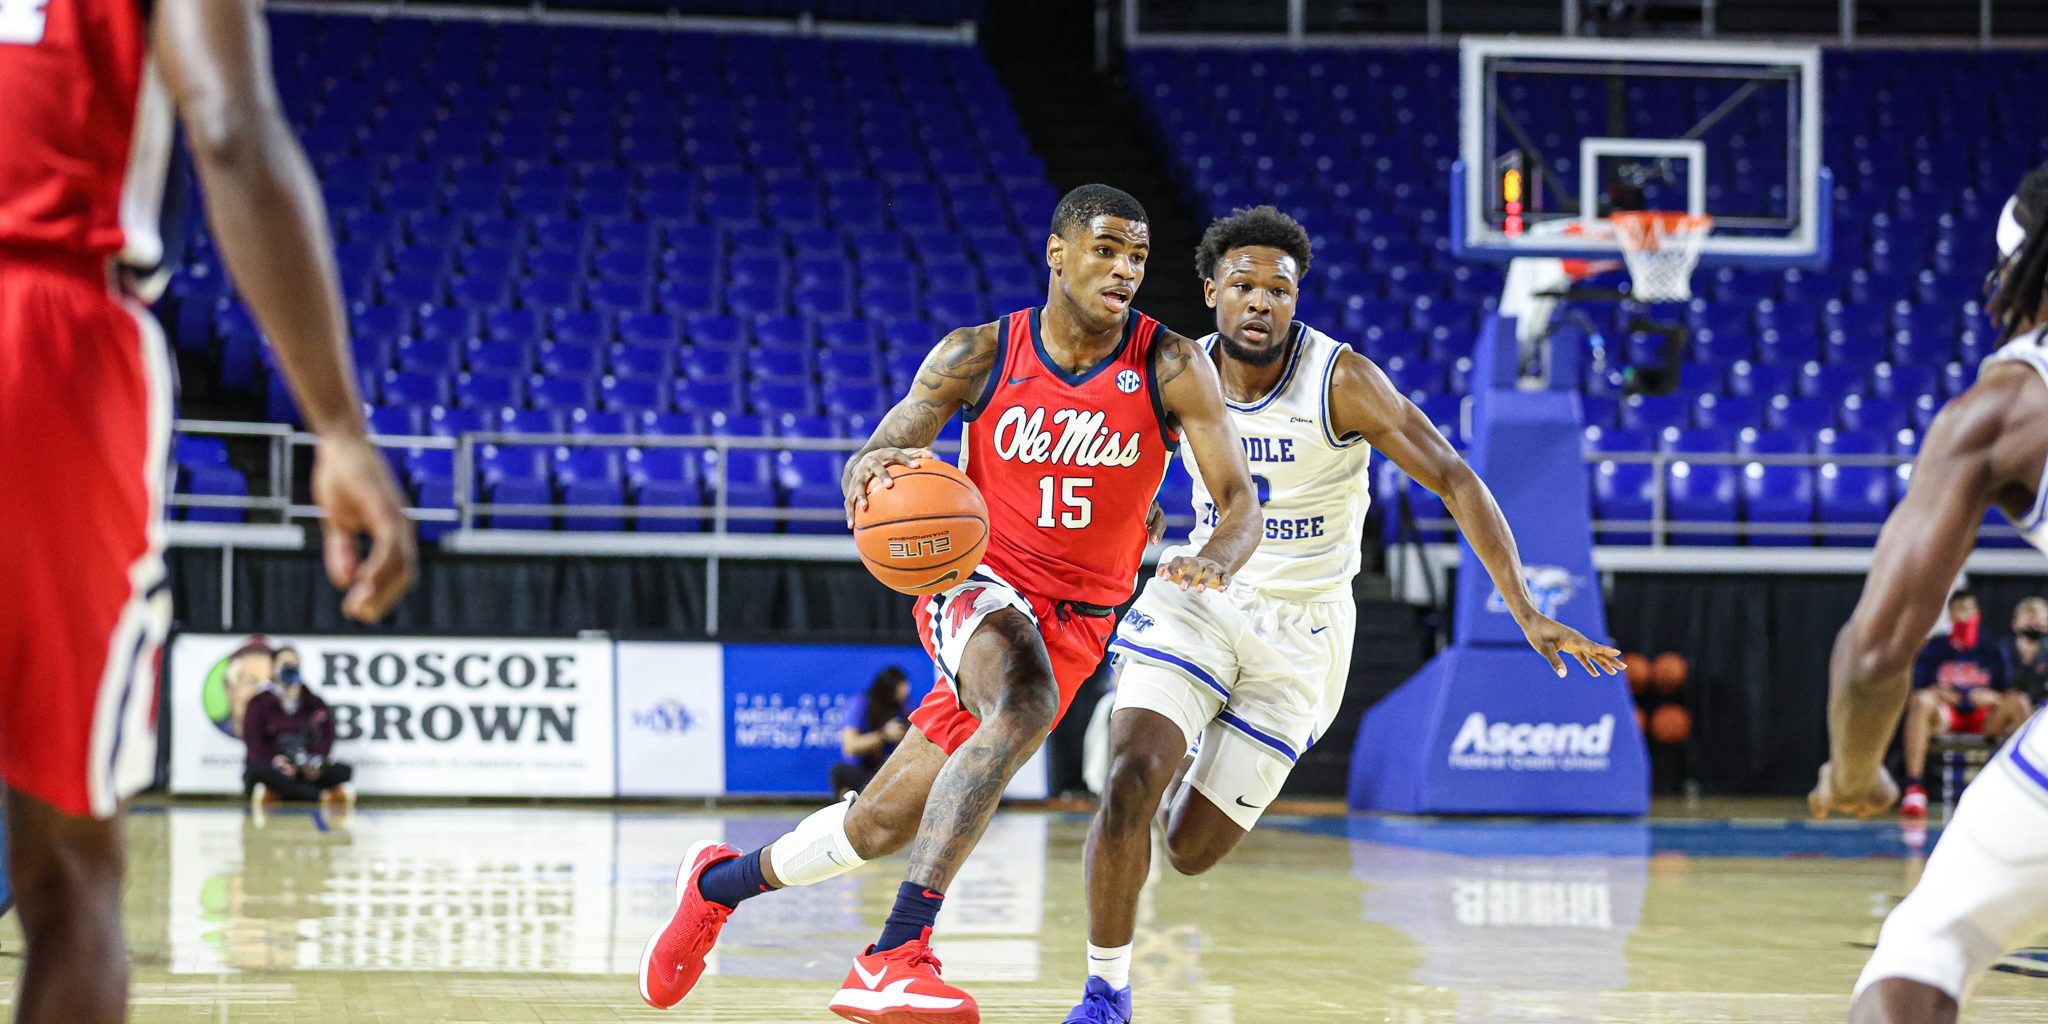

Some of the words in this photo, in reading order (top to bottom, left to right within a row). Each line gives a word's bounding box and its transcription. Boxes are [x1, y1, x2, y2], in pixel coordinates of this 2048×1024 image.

[1115, 369, 1143, 393] SEC
[993, 405, 1052, 464] Ole
[1051, 408, 1141, 467] Miss
[1241, 437, 1295, 462] DLE
[1037, 475, 1094, 529] 15
[889, 536, 951, 558] ELITE
[322, 653, 576, 689] ROSCOE
[332, 704, 576, 742] BROWN
[1450, 711, 1615, 757] Ascend
